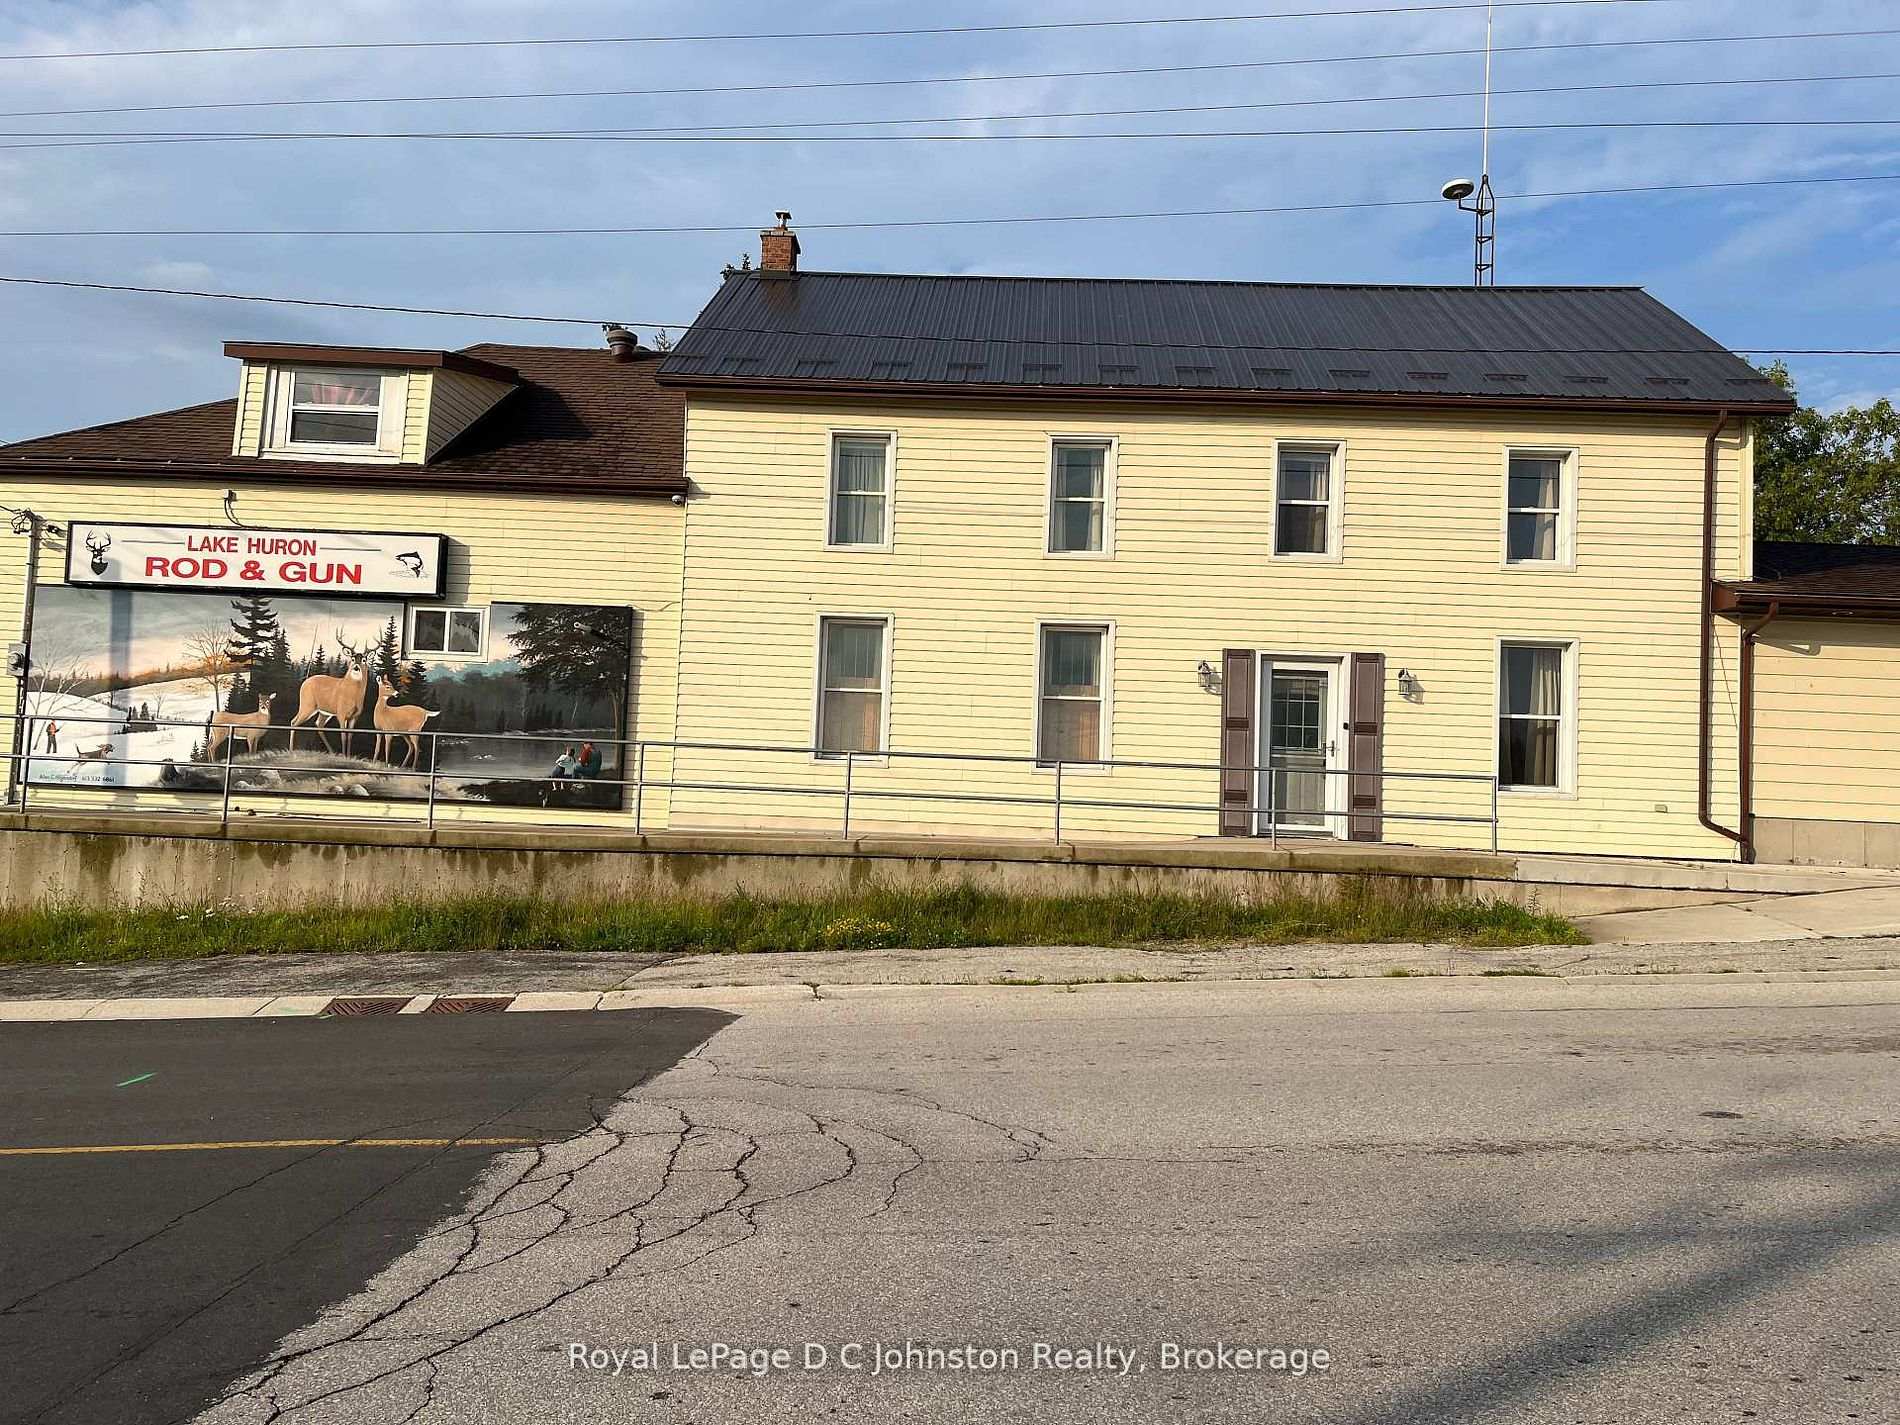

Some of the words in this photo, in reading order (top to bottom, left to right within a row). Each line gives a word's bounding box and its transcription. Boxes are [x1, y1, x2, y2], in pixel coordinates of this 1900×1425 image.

[187, 536, 239, 553] LAKE
[247, 537, 317, 556] HURON
[144, 556, 228, 579] ROD
[240, 559, 266, 581] &
[278, 561, 362, 585] GUN
